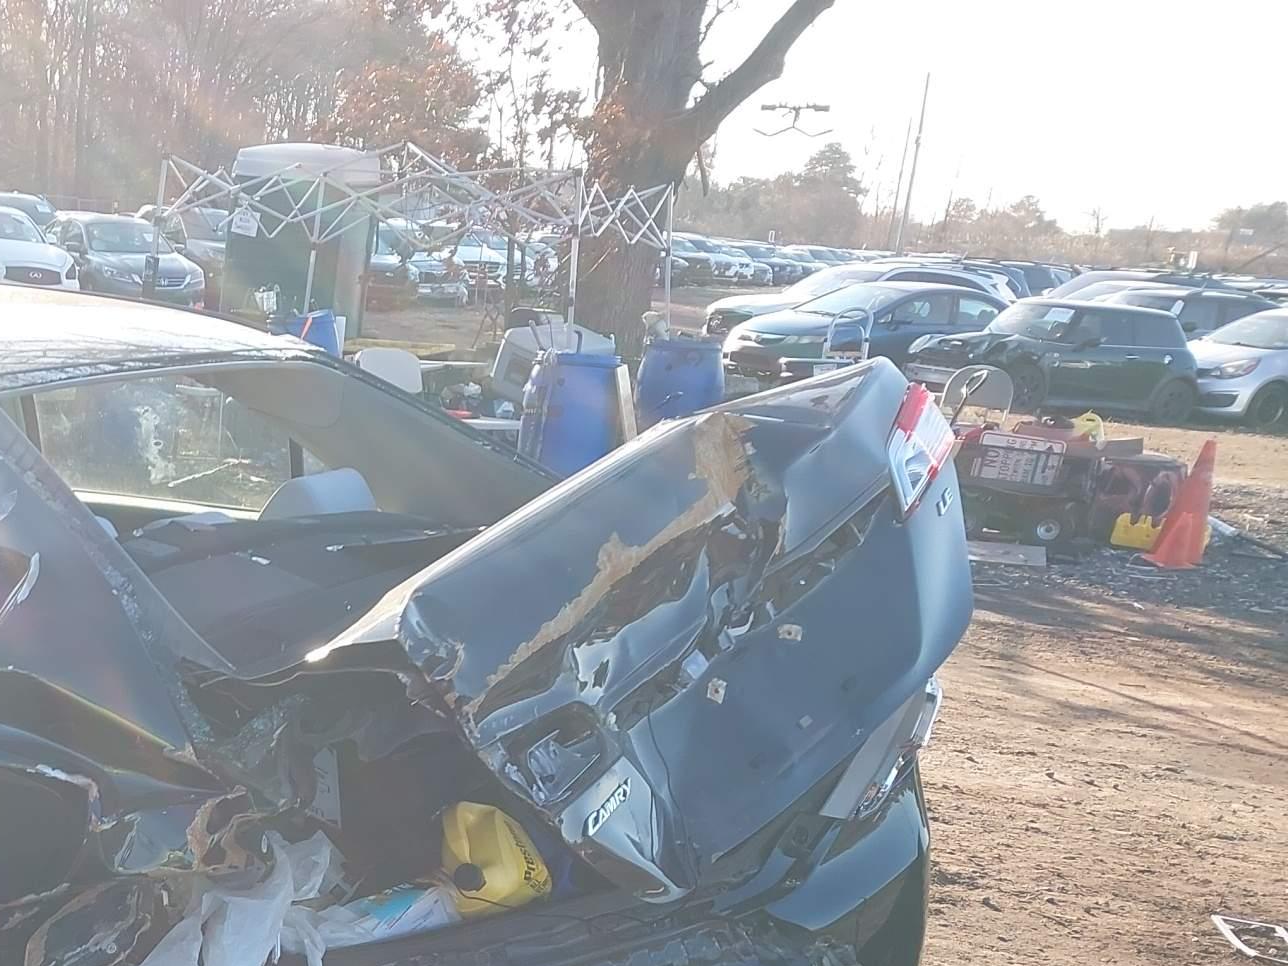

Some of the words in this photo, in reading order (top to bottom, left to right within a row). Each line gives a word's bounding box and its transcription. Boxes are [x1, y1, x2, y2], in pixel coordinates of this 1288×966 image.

[983, 449, 1000, 468] NO
[936, 486, 953, 517] LE
[585, 777, 631, 836] CAMRY
